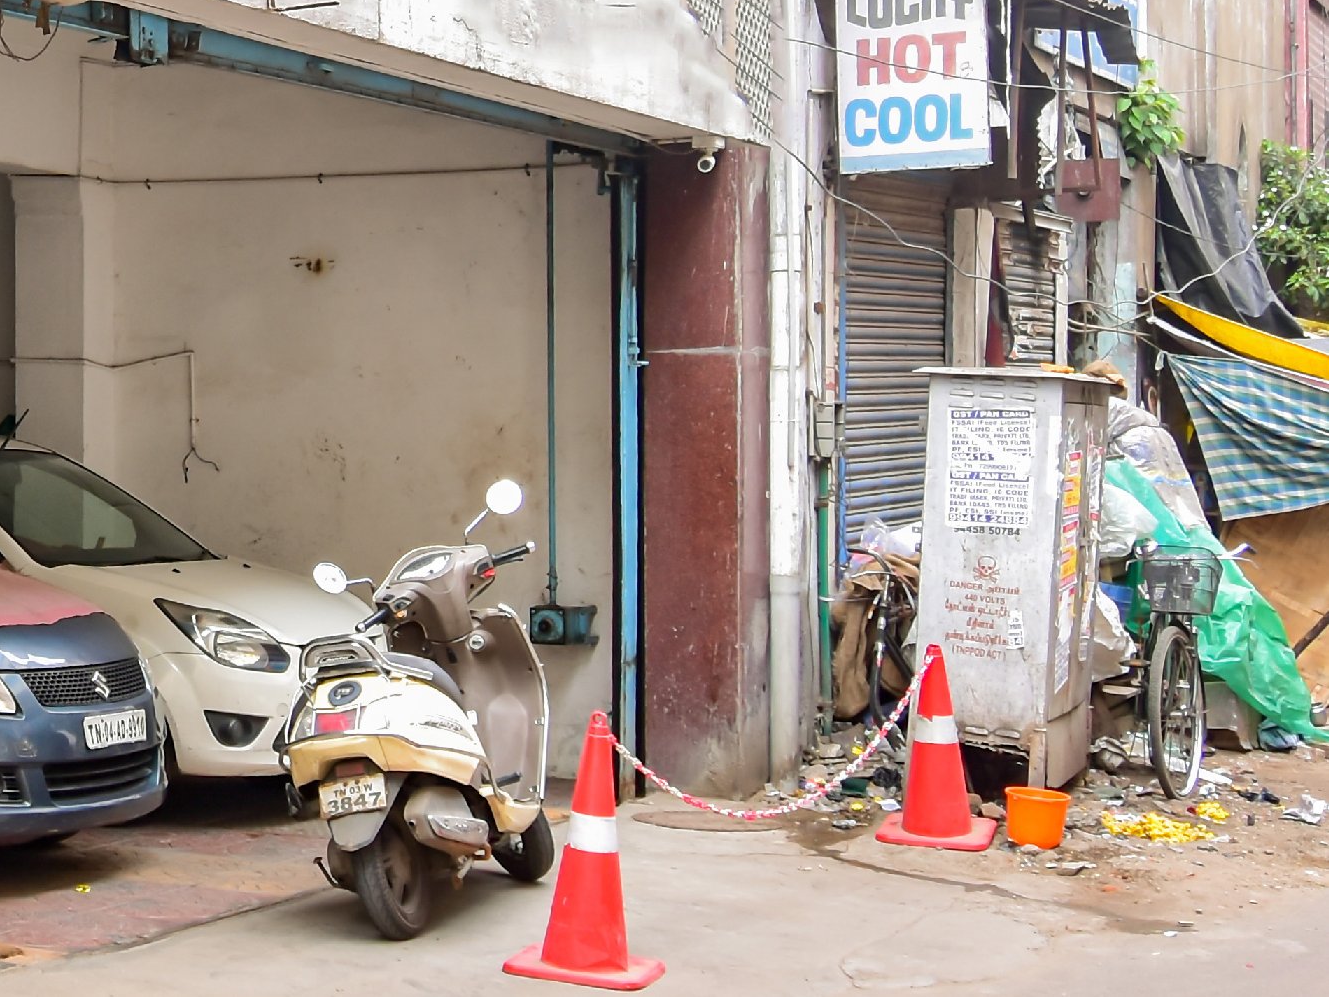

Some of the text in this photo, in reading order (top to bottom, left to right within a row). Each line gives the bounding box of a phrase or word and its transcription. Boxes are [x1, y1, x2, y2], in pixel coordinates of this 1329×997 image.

[856, 31, 967, 86] HOT
[844, 93, 974, 147] COOL
[950, 581, 983, 590] DANGER
[980, 596, 1006, 605] VOLTS
[333, 782, 374, 798] TN 03 W
[327, 791, 381, 816] 3847
